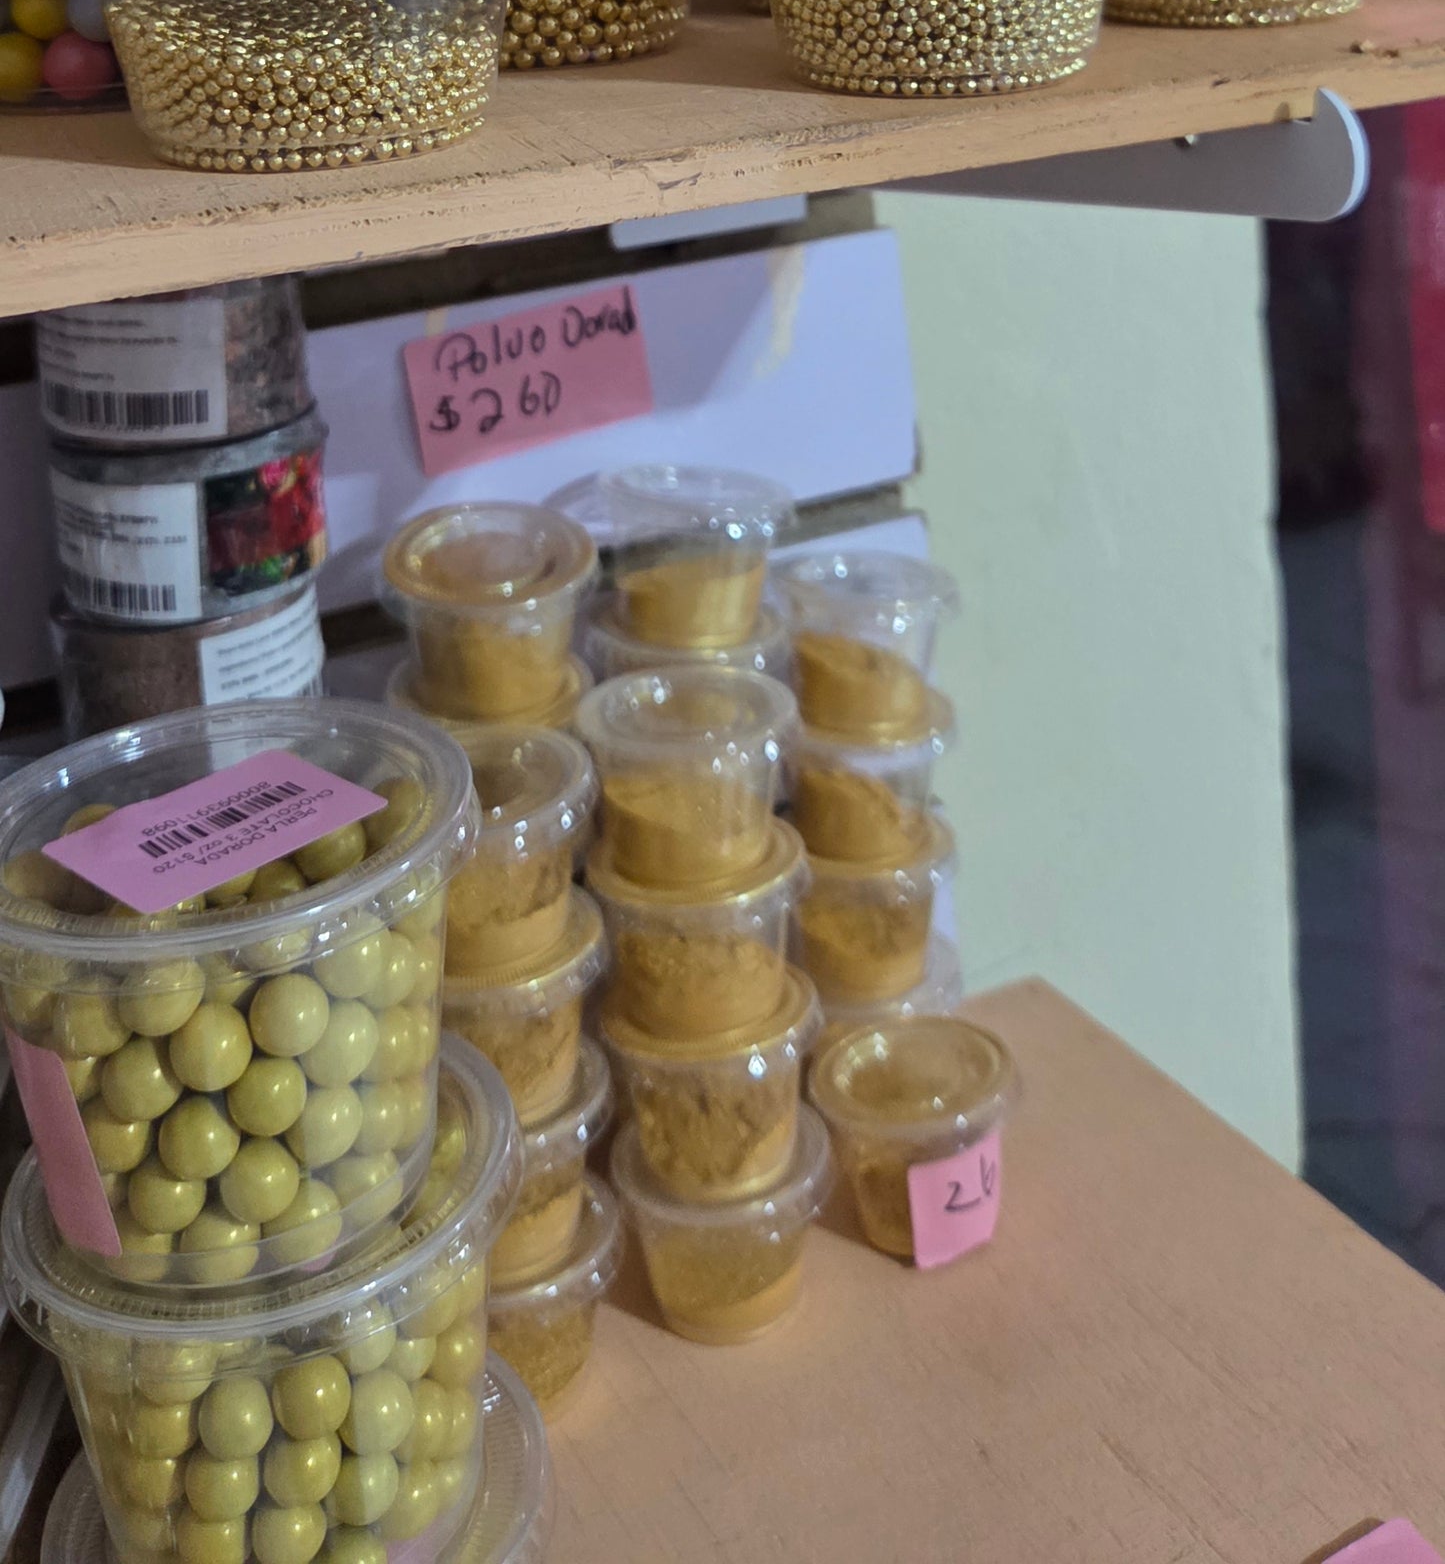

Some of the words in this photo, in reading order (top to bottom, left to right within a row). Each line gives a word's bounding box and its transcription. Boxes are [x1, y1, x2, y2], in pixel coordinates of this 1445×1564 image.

[239, 789, 335, 836] CHOCOLATE
[265, 807, 318, 833] PERLA
[193, 831, 266, 866] DORADA
